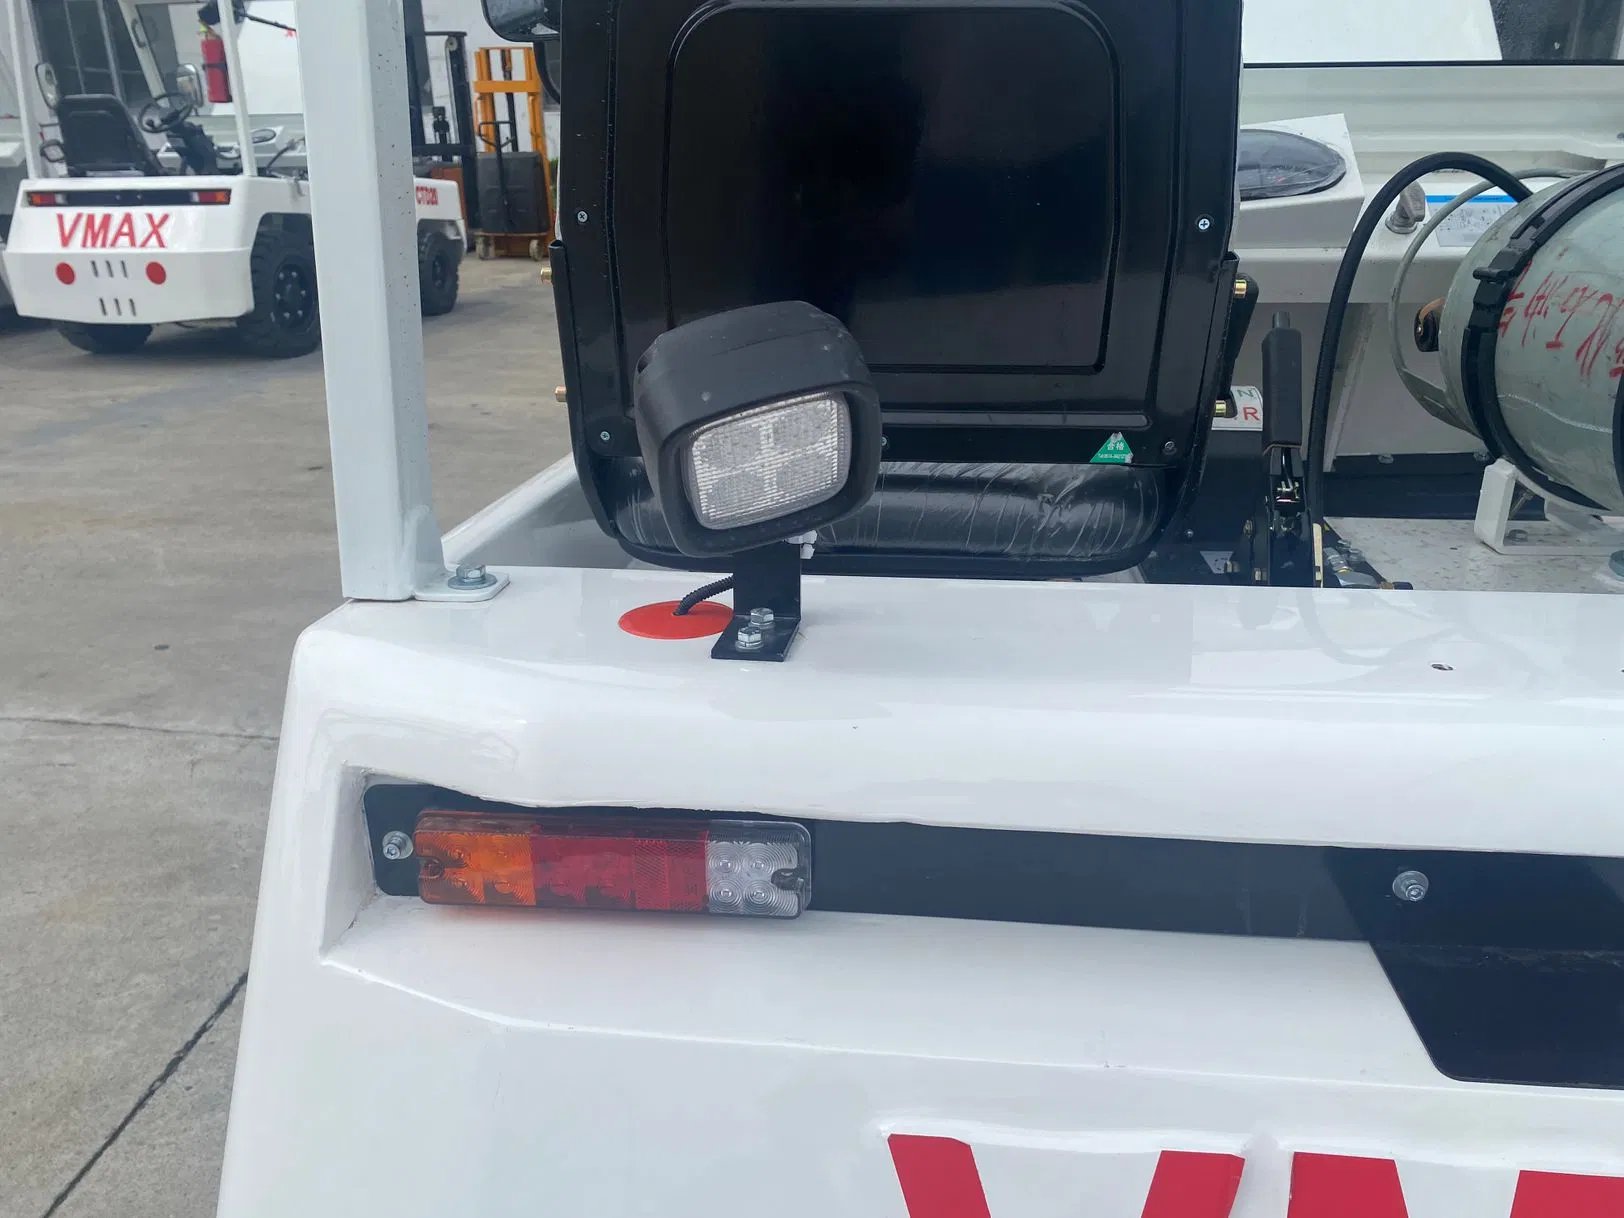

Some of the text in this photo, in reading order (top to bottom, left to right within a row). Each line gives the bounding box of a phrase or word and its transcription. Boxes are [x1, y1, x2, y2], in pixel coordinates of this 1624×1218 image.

[56, 212, 170, 248] VMAX
[1237, 389, 1254, 398] N
[1243, 406, 1260, 421] R
